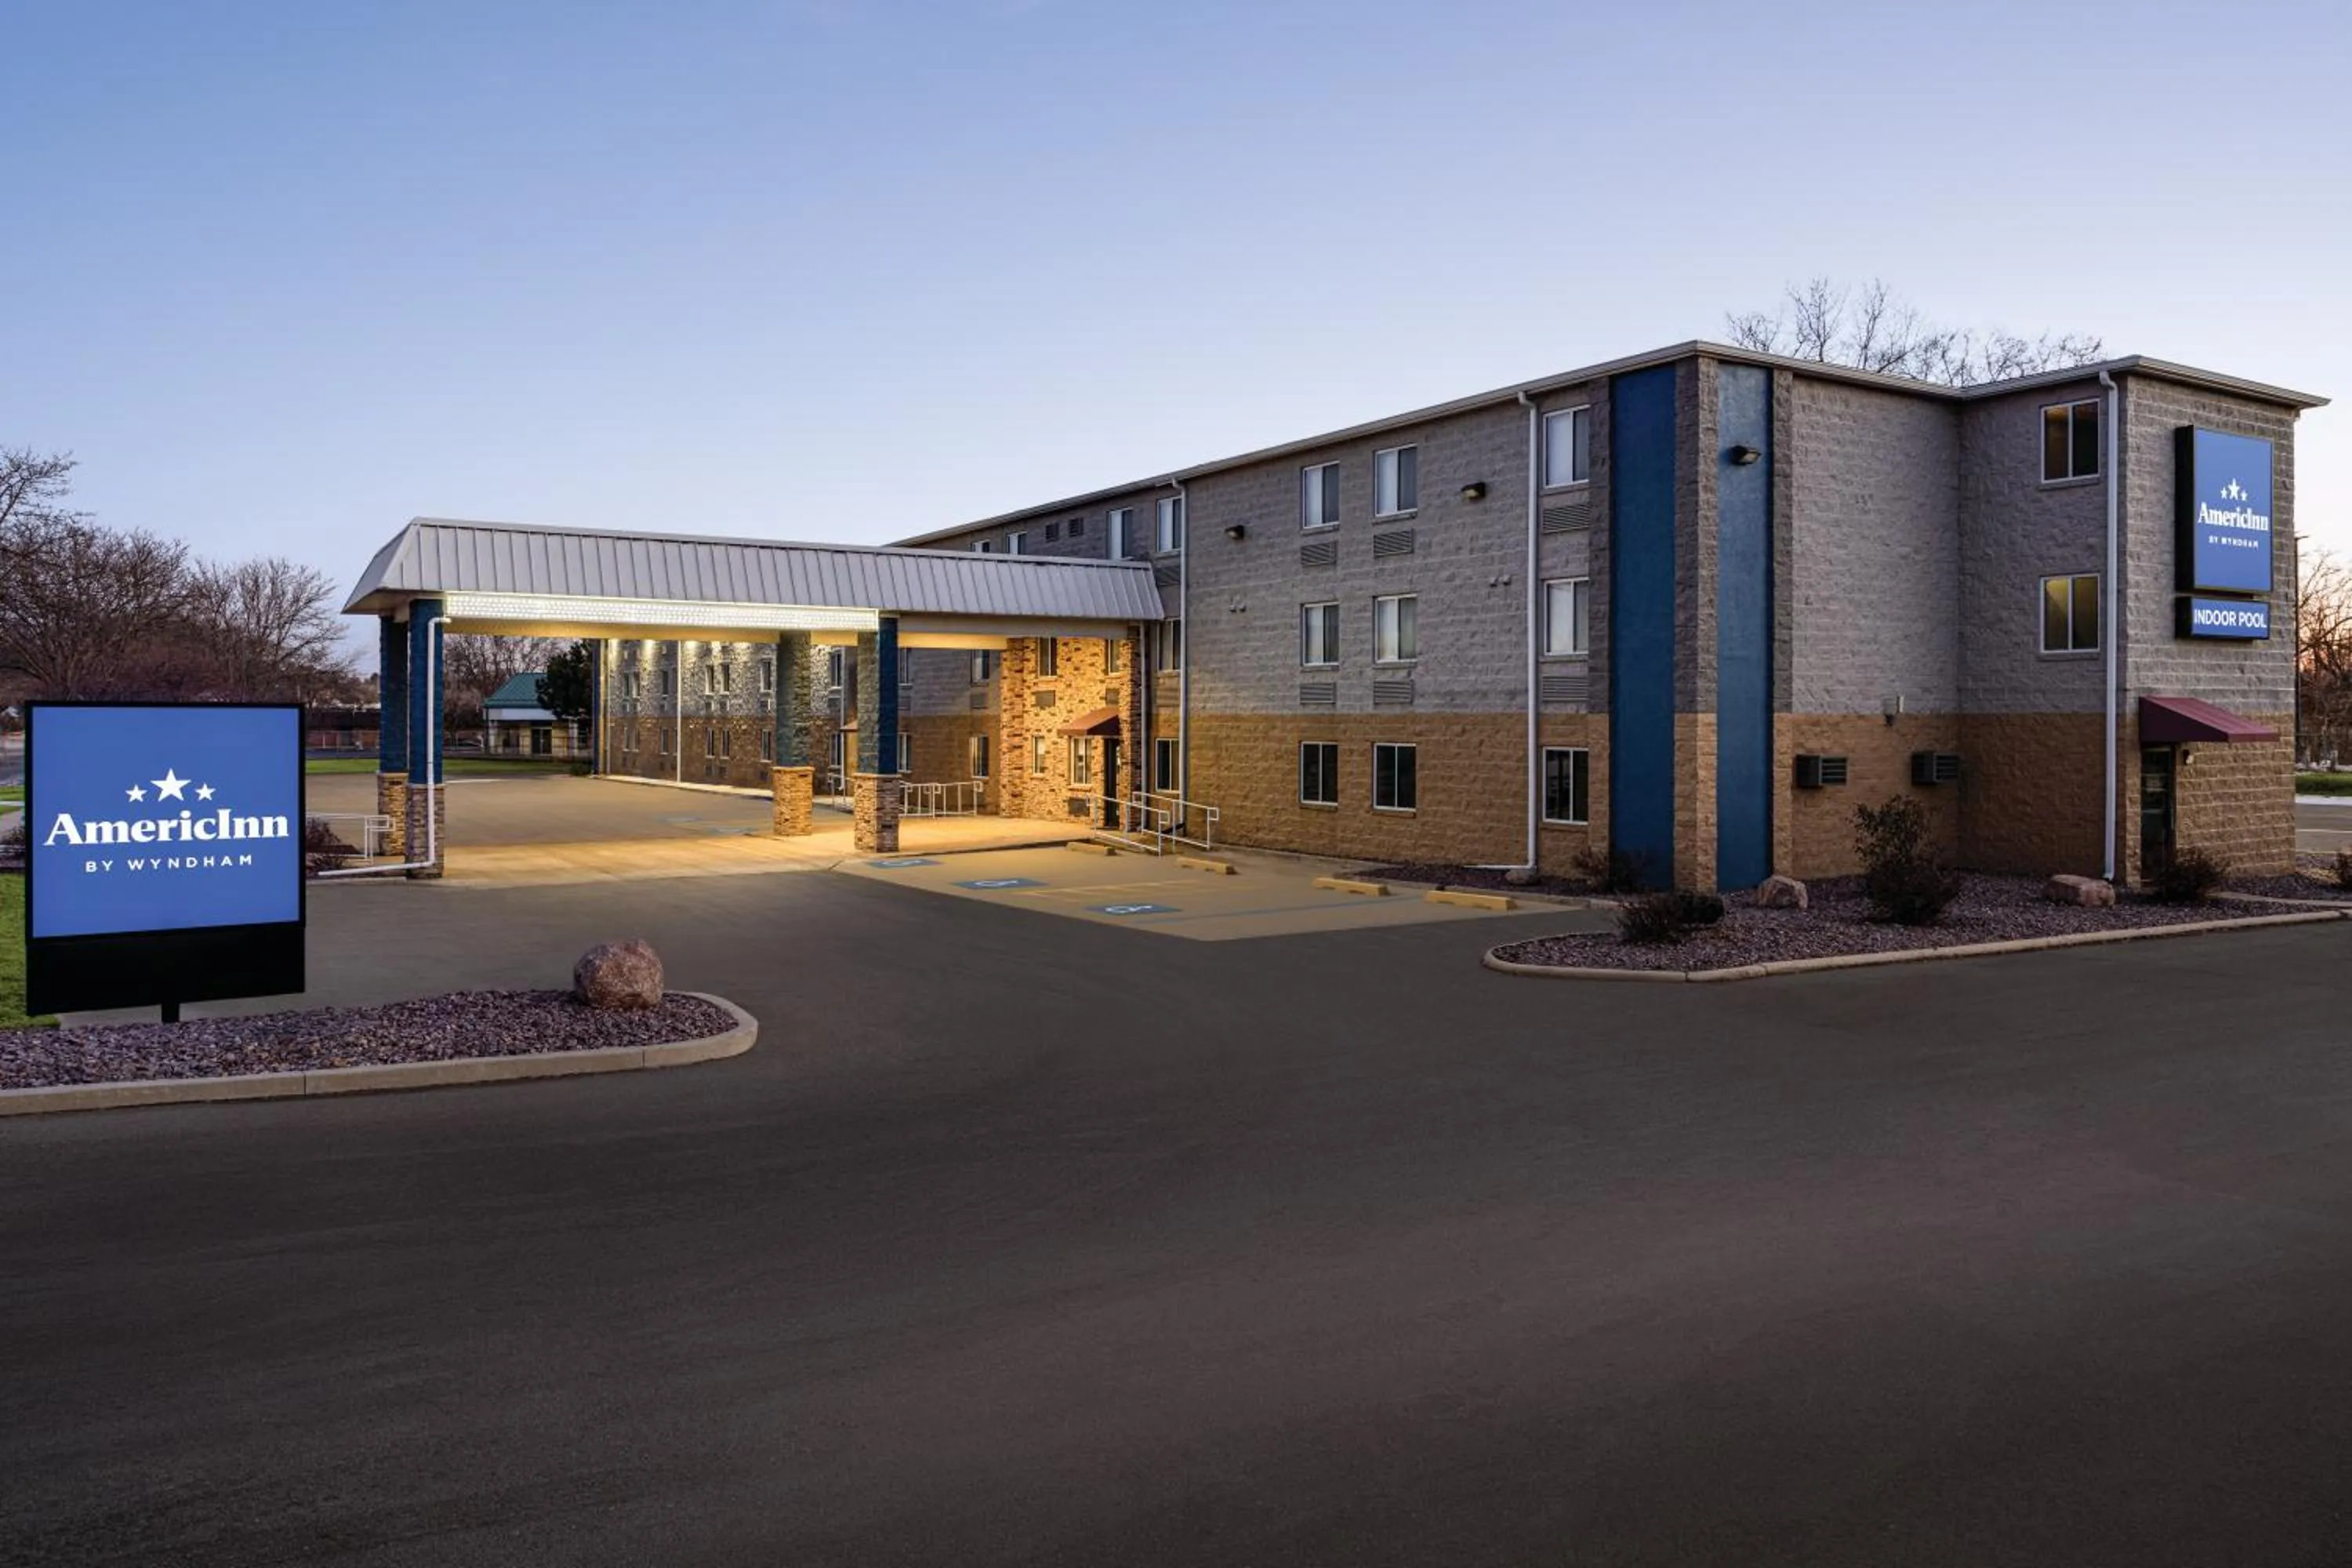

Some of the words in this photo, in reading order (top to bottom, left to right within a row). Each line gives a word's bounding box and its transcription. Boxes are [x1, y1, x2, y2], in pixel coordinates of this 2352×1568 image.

[2198, 502, 2268, 531] AmericInn
[2194, 609, 2237, 626] INDOOR
[2238, 612, 2267, 628] POOL
[42, 808, 289, 846] AmericInn
[85, 860, 113, 873] BY
[128, 855, 252, 870] WYNDHAM
